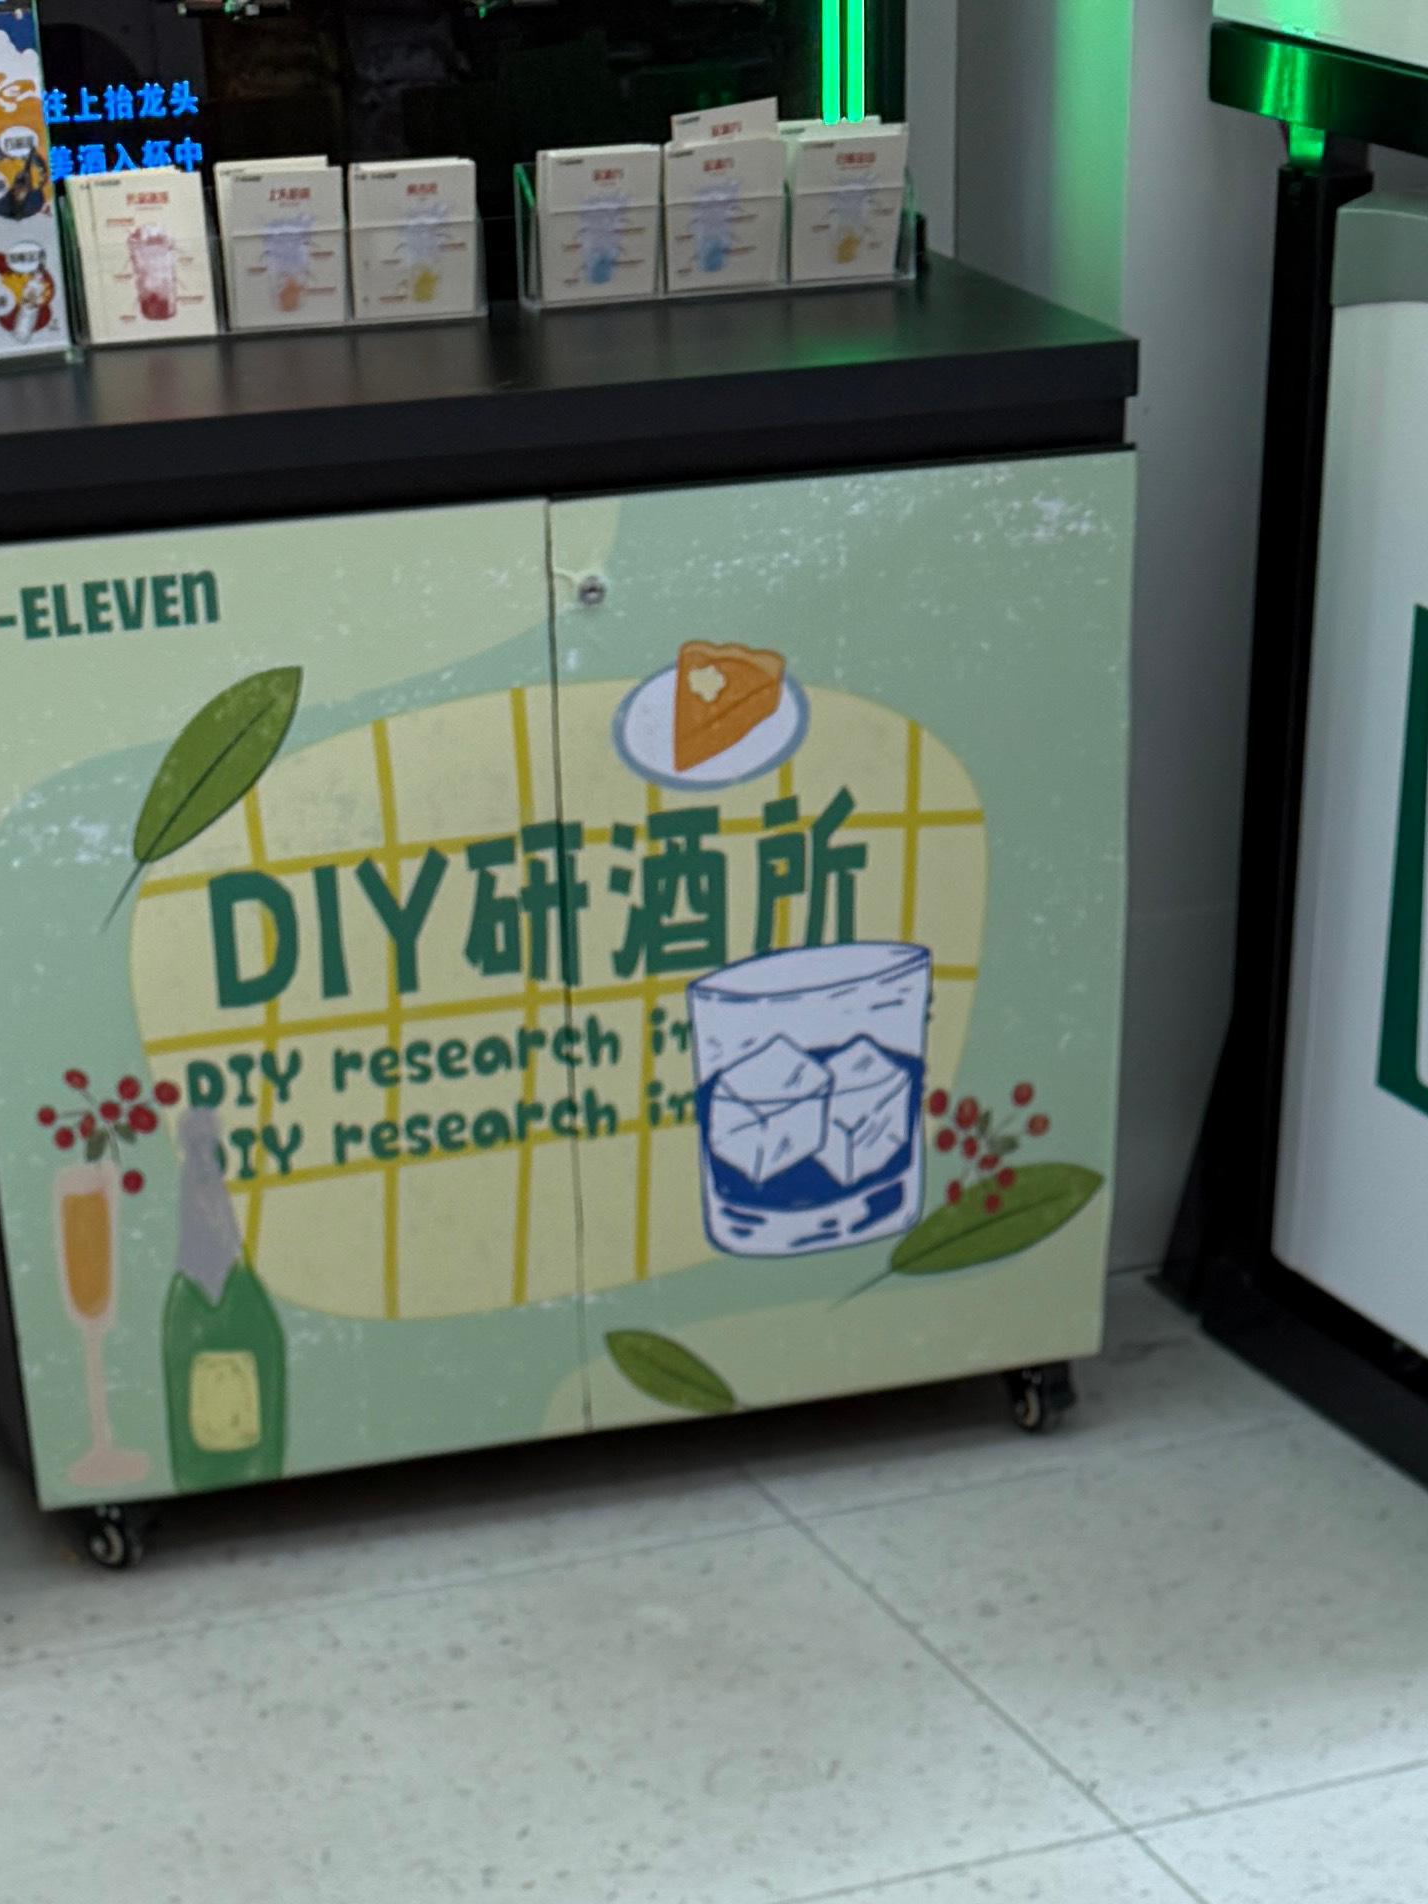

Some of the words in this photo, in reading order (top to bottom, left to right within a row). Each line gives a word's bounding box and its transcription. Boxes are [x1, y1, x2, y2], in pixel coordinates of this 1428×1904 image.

[187, 1049, 303, 1111] DIY
[332, 1014, 621, 1091] research
[216, 1123, 303, 1182] IY
[333, 1090, 619, 1167] research
